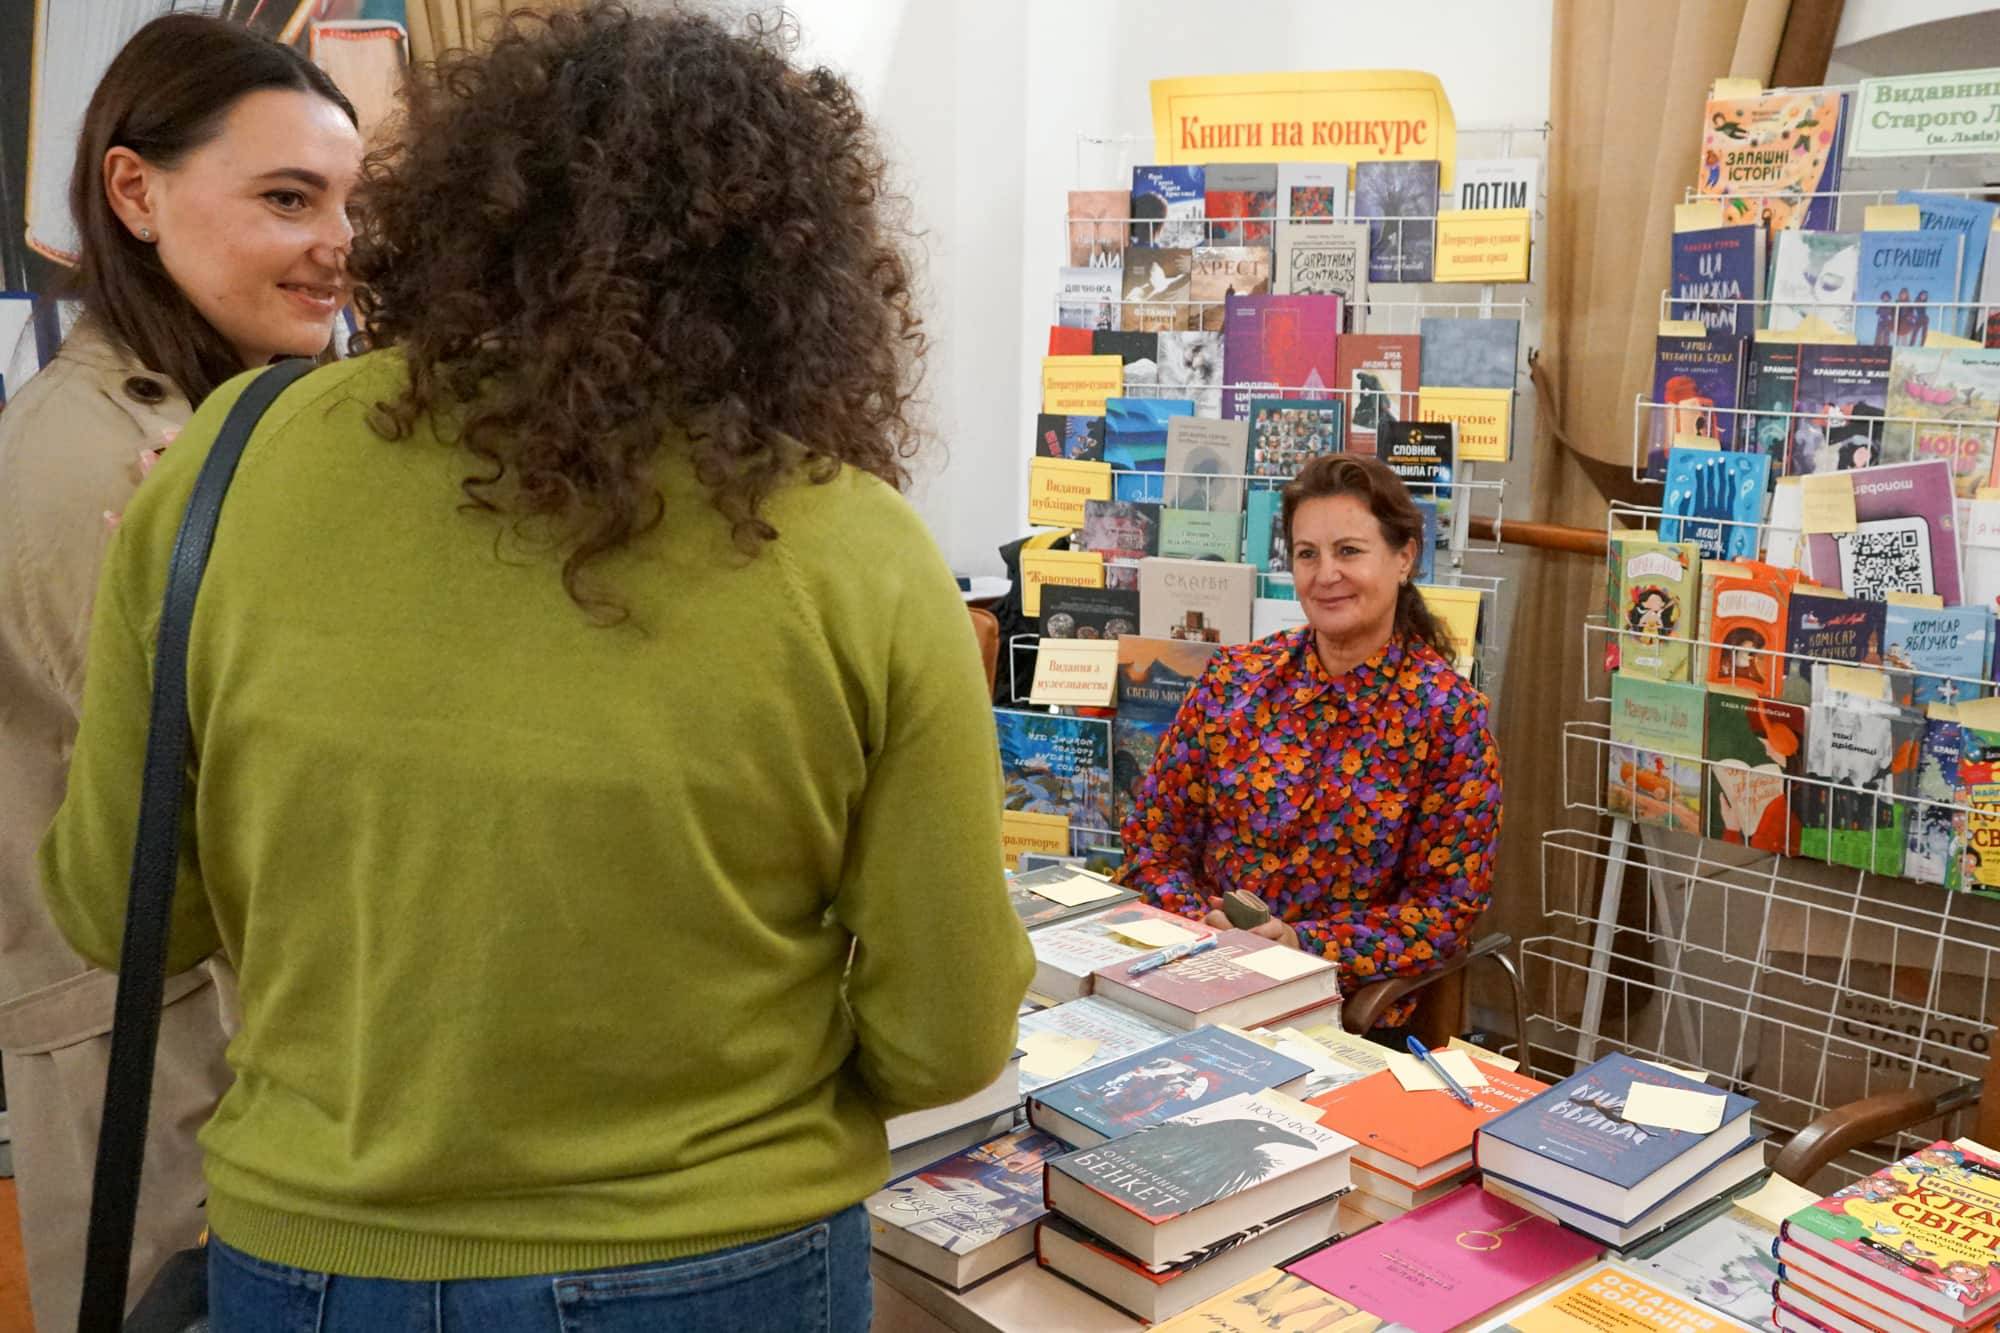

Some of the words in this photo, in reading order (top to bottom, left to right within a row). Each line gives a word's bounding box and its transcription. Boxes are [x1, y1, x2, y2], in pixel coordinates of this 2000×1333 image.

[1872, 109, 1978, 132] Старого
[1180, 115, 1263, 150] Книги
[1271, 121, 1304, 147] на
[1312, 119, 1428, 155] конкурс
[1726, 150, 1790, 166] ЗАПАШНІ
[1920, 210, 1979, 231] ТРАШНІ
[1293, 250, 1355, 269] CARPATHIAN
[1873, 243, 1945, 269] СТРАШНІ
[1197, 259, 1260, 277] ХРЕСТ
[1297, 269, 1355, 283] CONTRASTS
[1423, 410, 1497, 426] Наукове
[1459, 435, 1499, 446] ання
[1393, 445, 1437, 456] СЛОВНИК
[1390, 465, 1426, 477] РАВИЛА
[1046, 479, 1092, 496] Видання
[1031, 497, 1085, 513] публіцист
[1913, 617, 1961, 634] КОМІСАР
[1808, 630, 1857, 647] КОМІСАР
[1904, 635, 1959, 651] ЯБЛУЧКО
[1049, 660, 1092, 674] Видання
[1003, 835, 1060, 852] разотворче
[1241, 1101, 1290, 1128] ЛЮСІ
[1288, 1118, 1333, 1144] ФОЛІ
[1073, 1153, 1181, 1208] БЕНКЕТ
[1906, 1186, 2000, 1229] КЛА
[1587, 1283, 1697, 1333] КОЛОНІЯ
[1602, 1275, 1717, 1329] ОСТАННЯ
